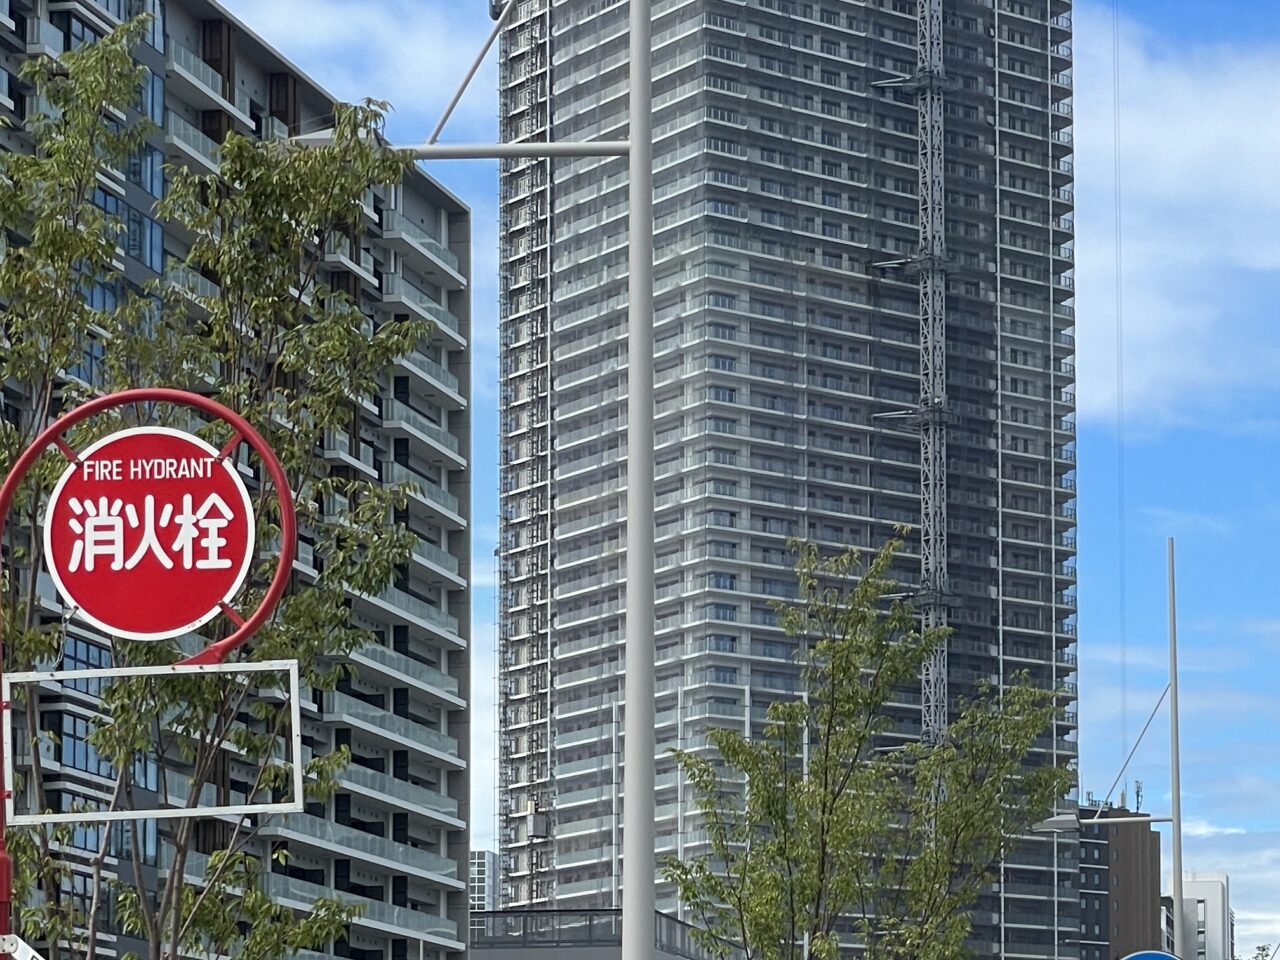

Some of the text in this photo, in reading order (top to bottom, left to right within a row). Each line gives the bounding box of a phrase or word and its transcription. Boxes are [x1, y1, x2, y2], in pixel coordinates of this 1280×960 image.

[83, 457, 215, 481] FIRE HYDRANT
[68, 492, 235, 573] 消火栓
